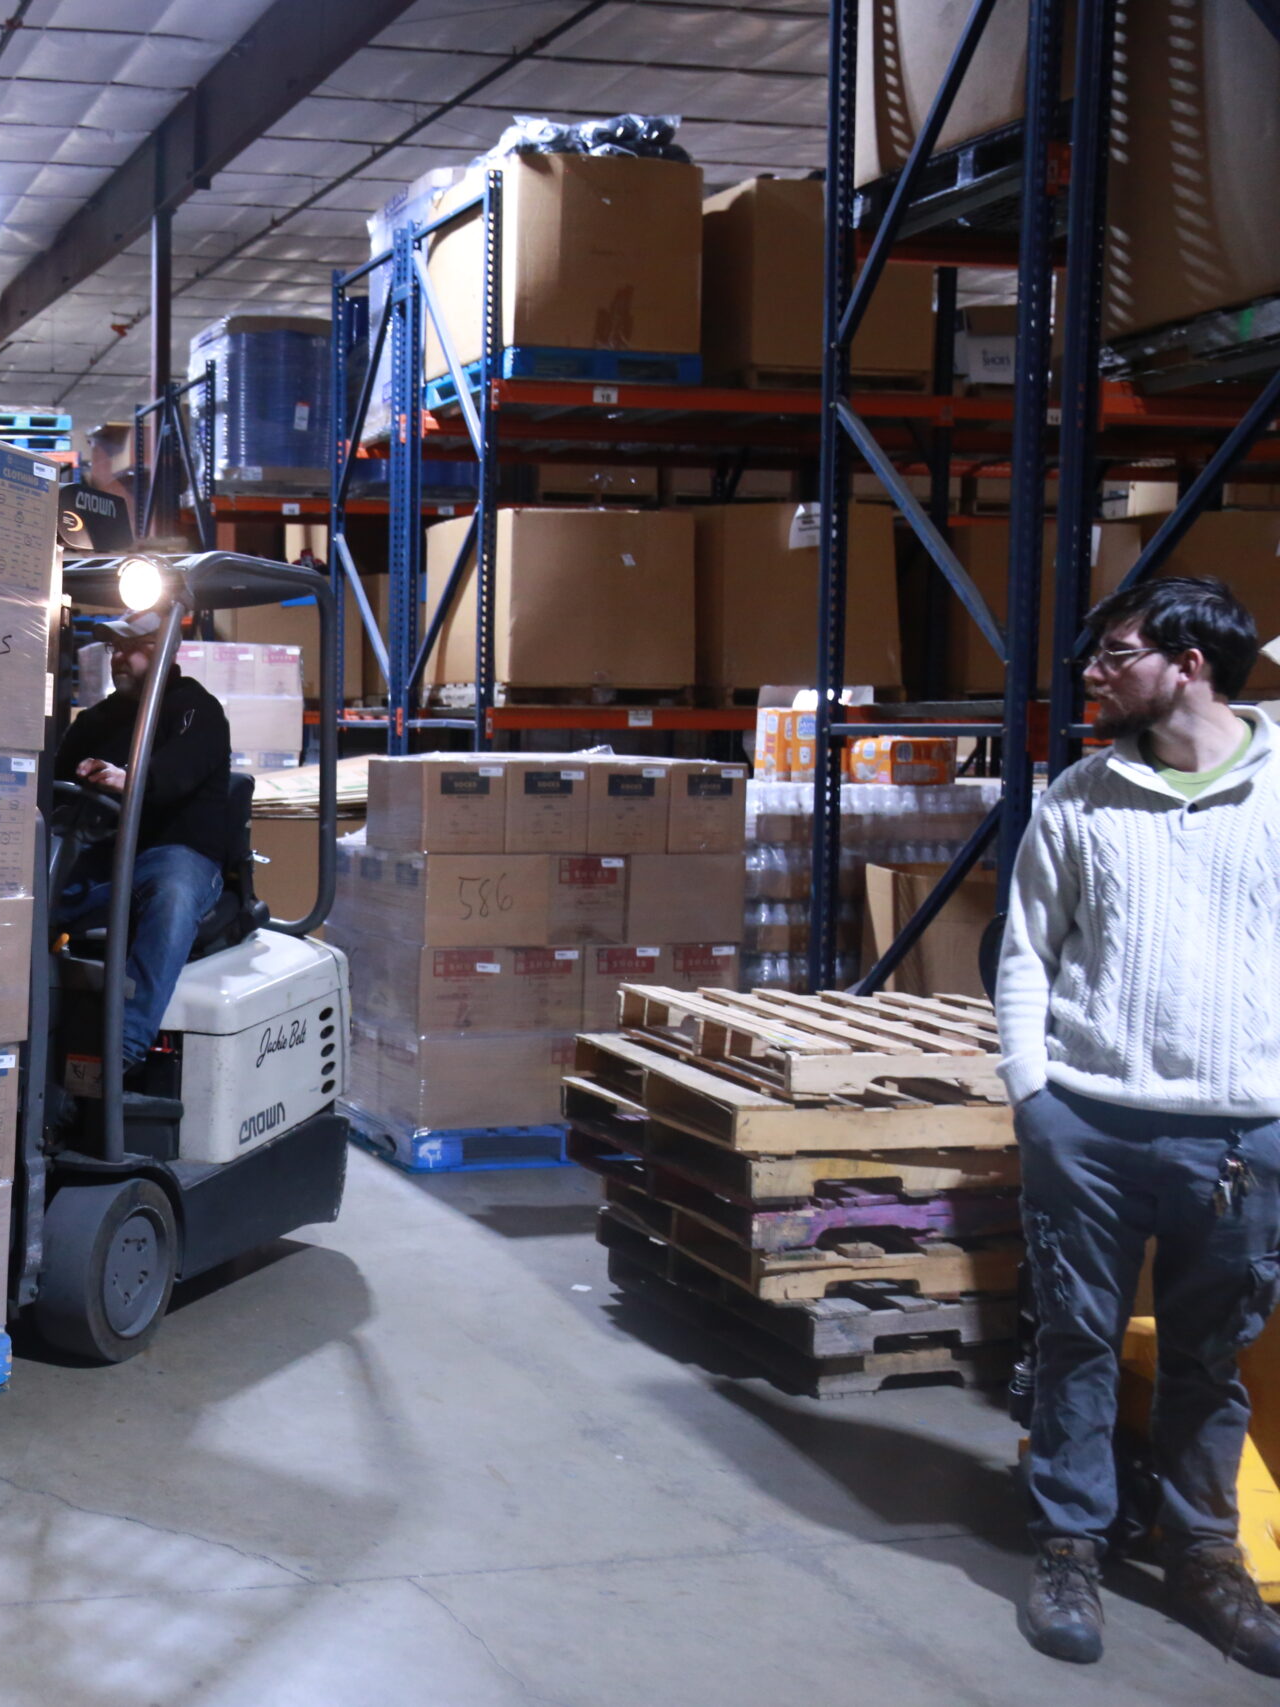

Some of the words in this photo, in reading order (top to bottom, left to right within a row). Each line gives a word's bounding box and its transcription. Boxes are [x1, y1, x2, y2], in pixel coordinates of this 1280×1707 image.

[2, 468, 39, 486] CLOTHING
[75, 491, 116, 518] CROWN
[457, 873, 513, 921] 586
[612, 960, 648, 969] SHOES
[256, 1023, 288, 1068] Jackie
[239, 1101, 286, 1145] CROWN
